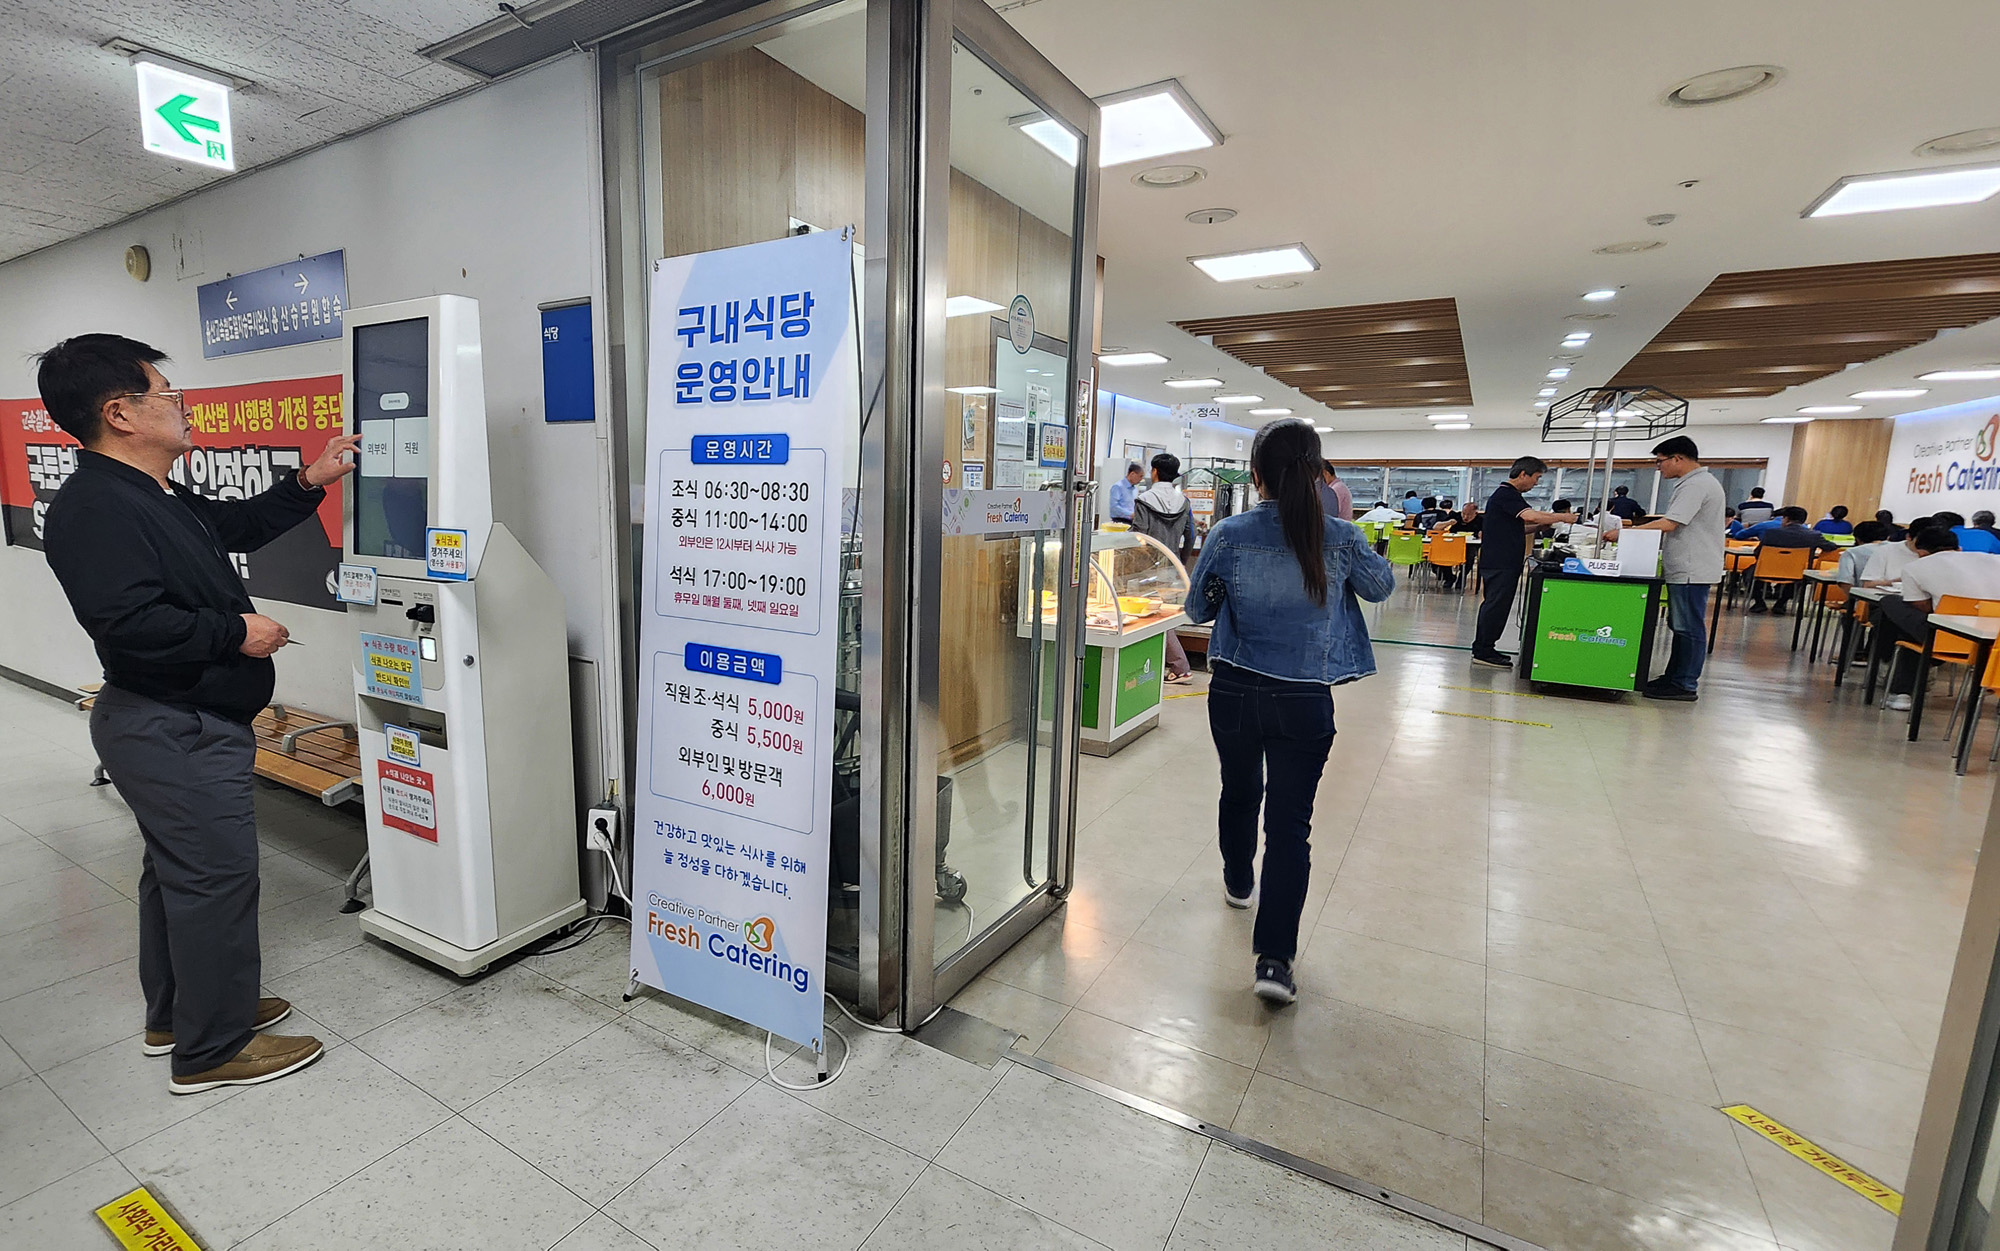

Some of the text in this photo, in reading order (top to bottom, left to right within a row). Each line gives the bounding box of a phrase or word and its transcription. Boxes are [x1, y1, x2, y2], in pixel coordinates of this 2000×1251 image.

[544, 326, 559, 340] 식당
[677, 291, 815, 348] 구내식당
[676, 353, 811, 404] 운영안내
[21, 409, 52, 433] 고속철도
[187, 392, 344, 434] 재산법 시행령 개정 중단
[1197, 407, 1220, 418] 정식
[367, 442, 419, 455] 외부인 직원
[705, 439, 773, 459] 운영시간
[1913, 438, 1974, 458] Creative Partner
[26, 446, 79, 490] 국토부
[1906, 464, 1943, 494] Fresh
[672, 480, 809, 502] 조식 06:30~08:30
[33, 500, 50, 540] S
[671, 508, 808, 533] 중식 11:00~14:00
[986, 512, 1029, 524] Fresh Catering
[431, 547, 463, 558] 챙겨주세요!
[678, 535, 797, 555] 외부인은 12시부터 식사 가능
[1588, 561, 1620, 571] PLUS 코너
[669, 565, 806, 597] 석식 17:00~19:00
[674, 591, 799, 617] 휴무일 매월 둘째, 넷째 일요일
[371, 640, 408, 655] 식권 수량 확인
[1548, 631, 1627, 647] Fresh Catering
[371, 655, 412, 673] 식권 나오는 입구
[700, 650, 765, 677] 이용금액
[376, 672, 391, 684] 반드시
[664, 682, 804, 725] 직원 조·석식 5,000원
[711, 718, 803, 755] 중식 5,500원
[678, 746, 782, 787] 외부인 및 방문객
[702, 779, 755, 807] 6,000원
[653, 820, 806, 875] 건강하고 맛있는 식사를 위해
[663, 848, 792, 900] 늘 정성을 다하겠습니다.
[648, 893, 740, 932] Creative Partner
[648, 911, 809, 993] Fresh Catering
[1741, 1113, 1890, 1199] 사회적 거리두기
[118, 1200, 158, 1236] 사회적
